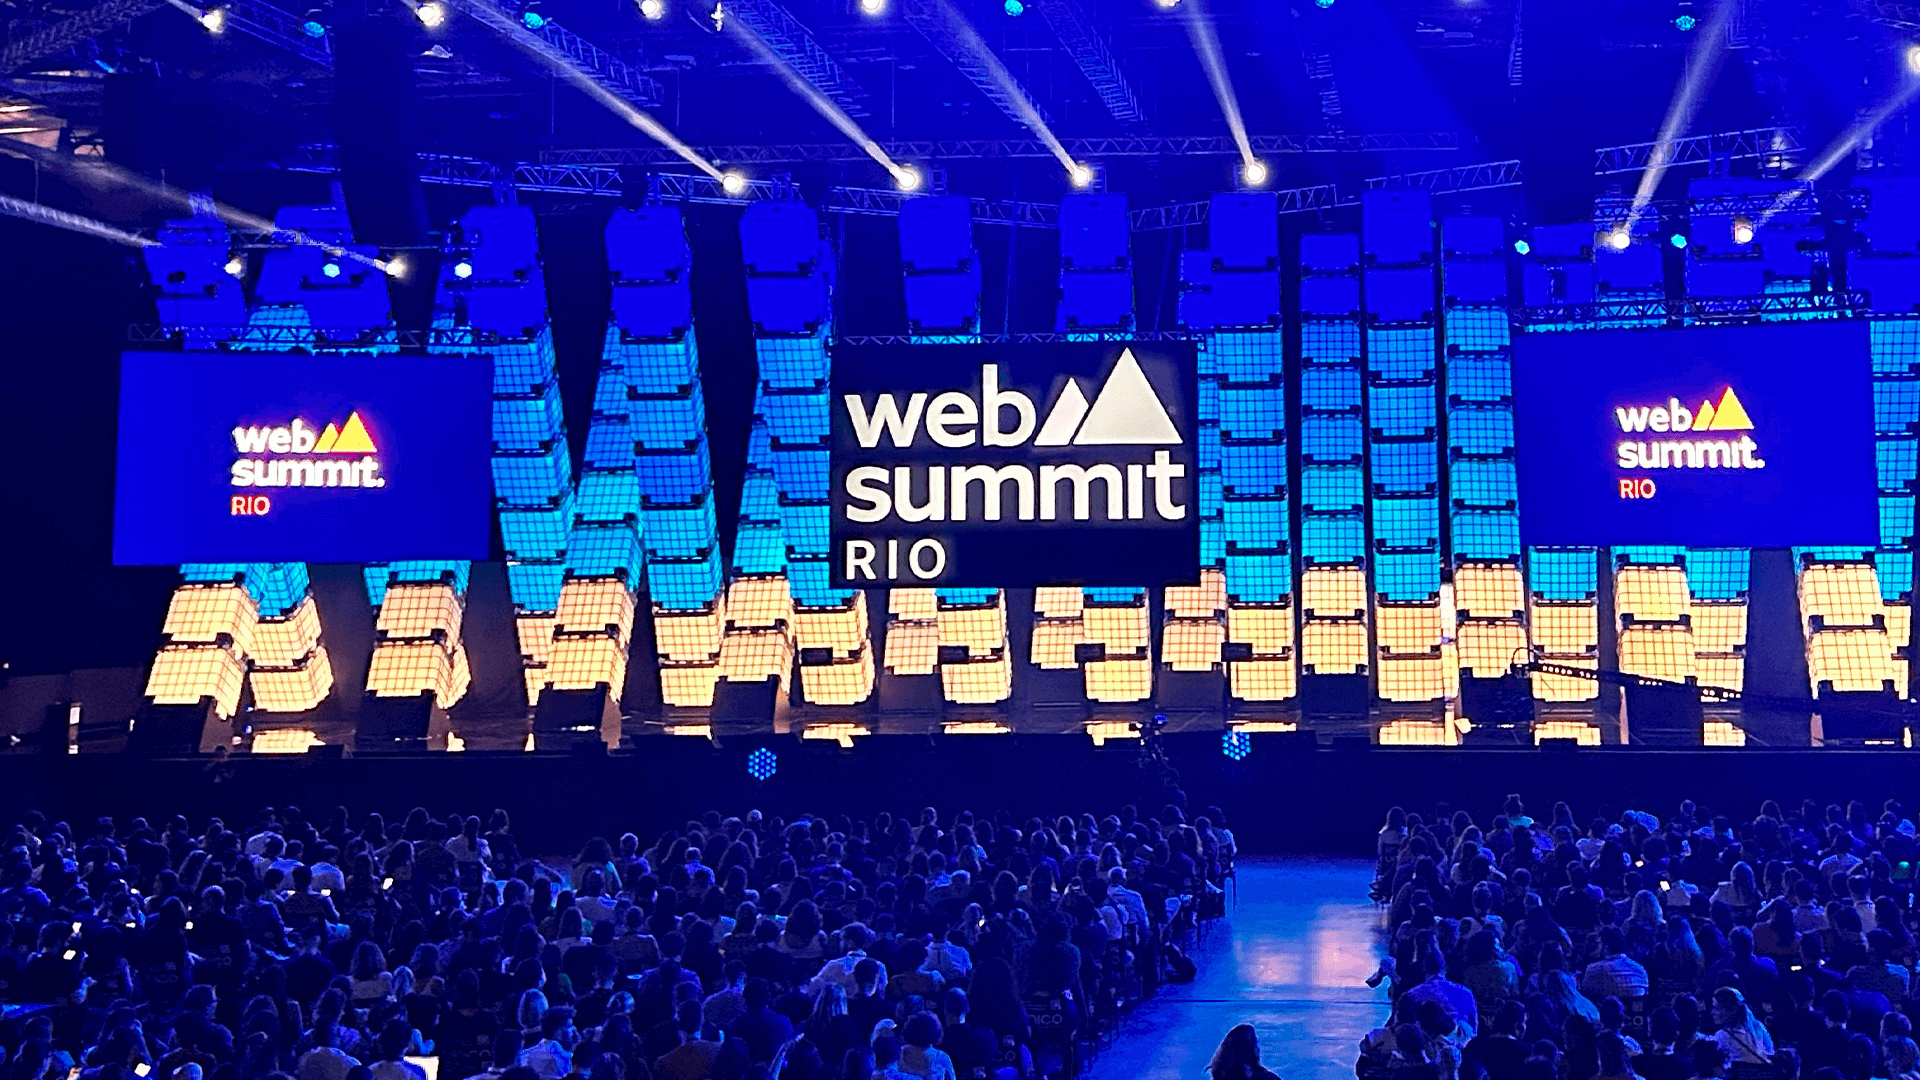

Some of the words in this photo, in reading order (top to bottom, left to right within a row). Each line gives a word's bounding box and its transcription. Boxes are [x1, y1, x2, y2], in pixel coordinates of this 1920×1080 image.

[844, 363, 1036, 447] web
[1615, 397, 1693, 432] web
[231, 418, 315, 453] web
[1617, 434, 1766, 469] summit.
[230, 455, 386, 487] summit.
[845, 450, 1186, 522] summit
[1619, 478, 1657, 499] RIO
[231, 494, 271, 516] RIO
[845, 538, 946, 579] RIO
